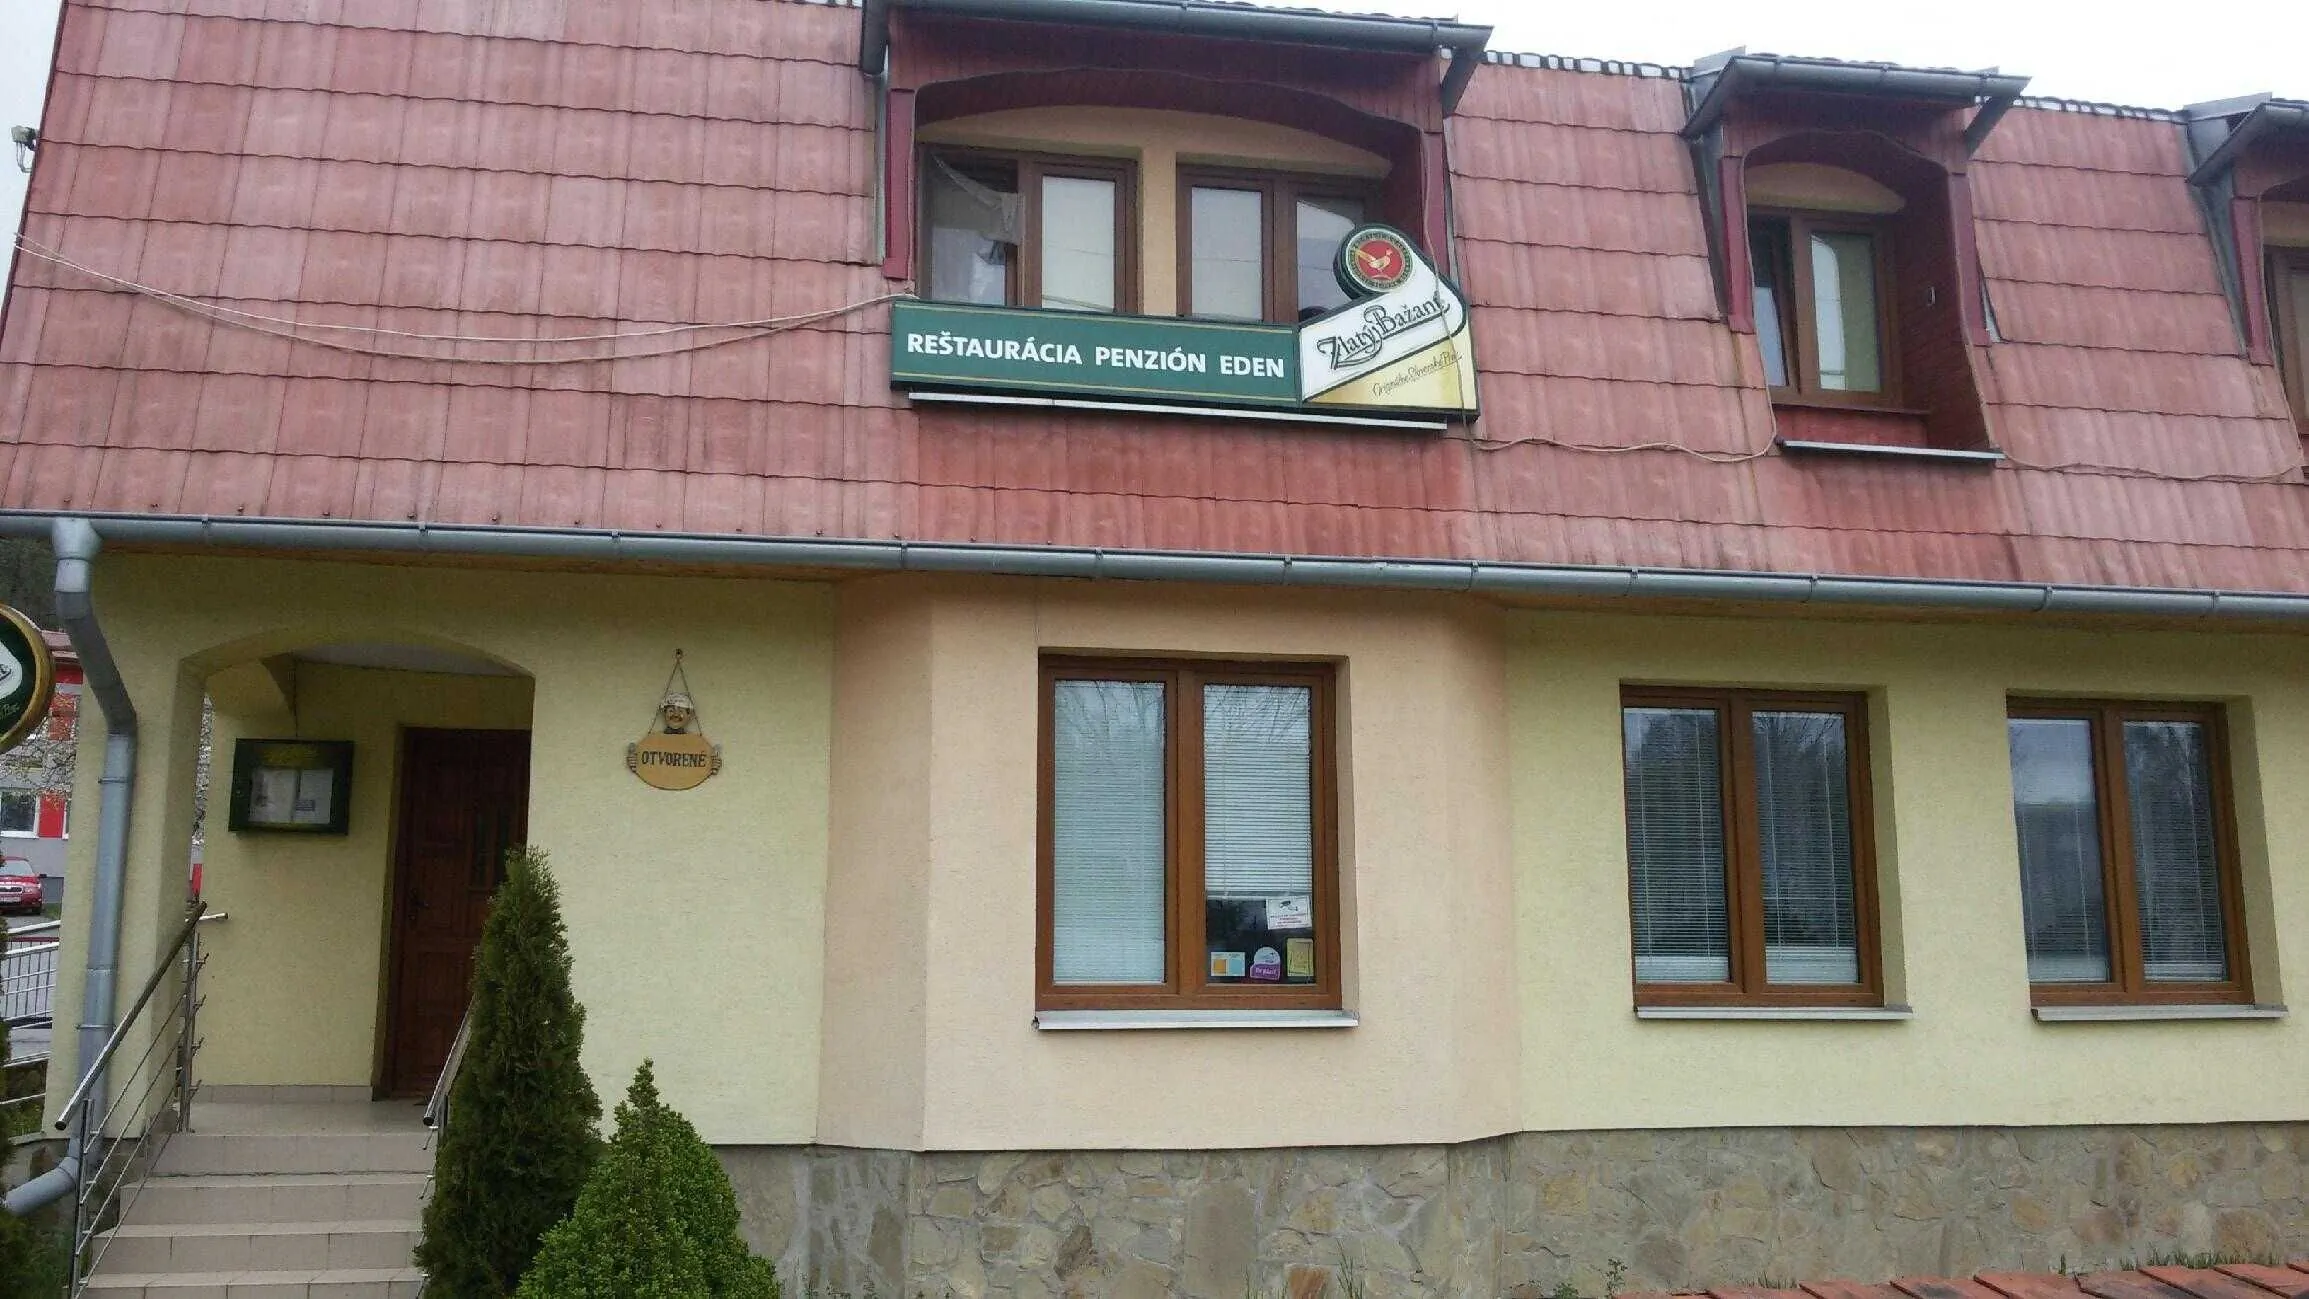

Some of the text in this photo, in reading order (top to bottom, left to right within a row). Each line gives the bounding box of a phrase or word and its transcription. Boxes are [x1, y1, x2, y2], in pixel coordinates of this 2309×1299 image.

[906, 330, 1285, 378] REŠTAURÁCIA PENZIÓN EDEN
[1316, 324, 1383, 370] Zlatý
[641, 750, 707, 768] OTVORENÉ
